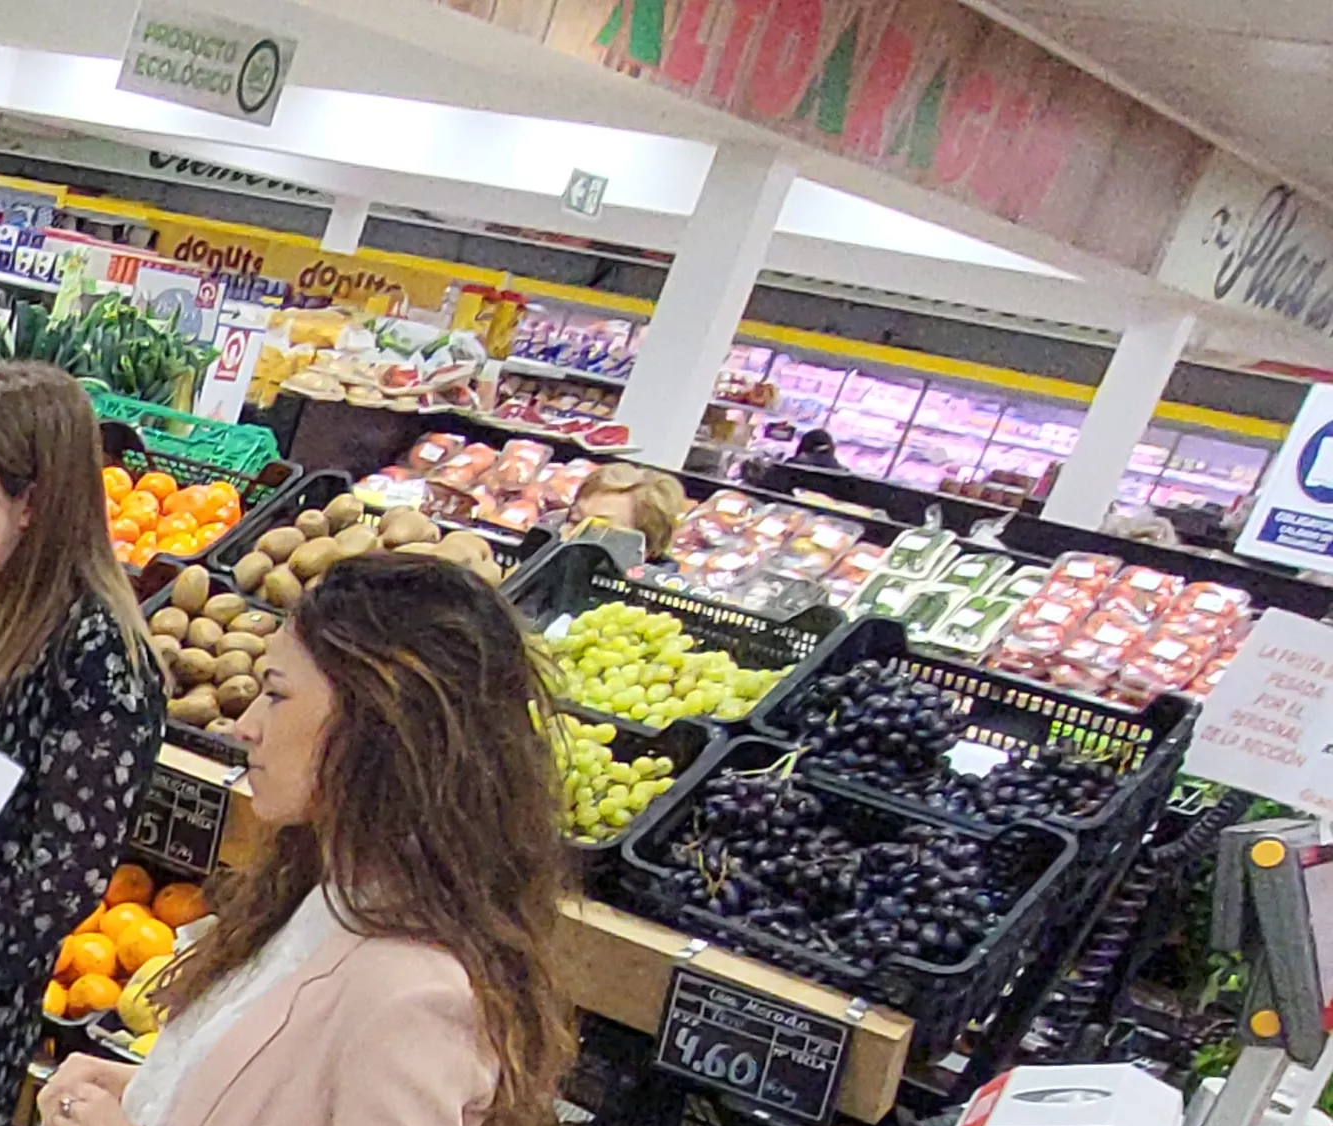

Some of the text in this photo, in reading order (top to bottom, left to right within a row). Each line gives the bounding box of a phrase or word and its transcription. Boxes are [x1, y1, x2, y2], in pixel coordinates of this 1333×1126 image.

[144, 21, 238, 63] PRODUCTO
[174, 234, 264, 278] donuts
[741, 998, 812, 1033] Morada
[674, 1025, 758, 1087] 4.60
